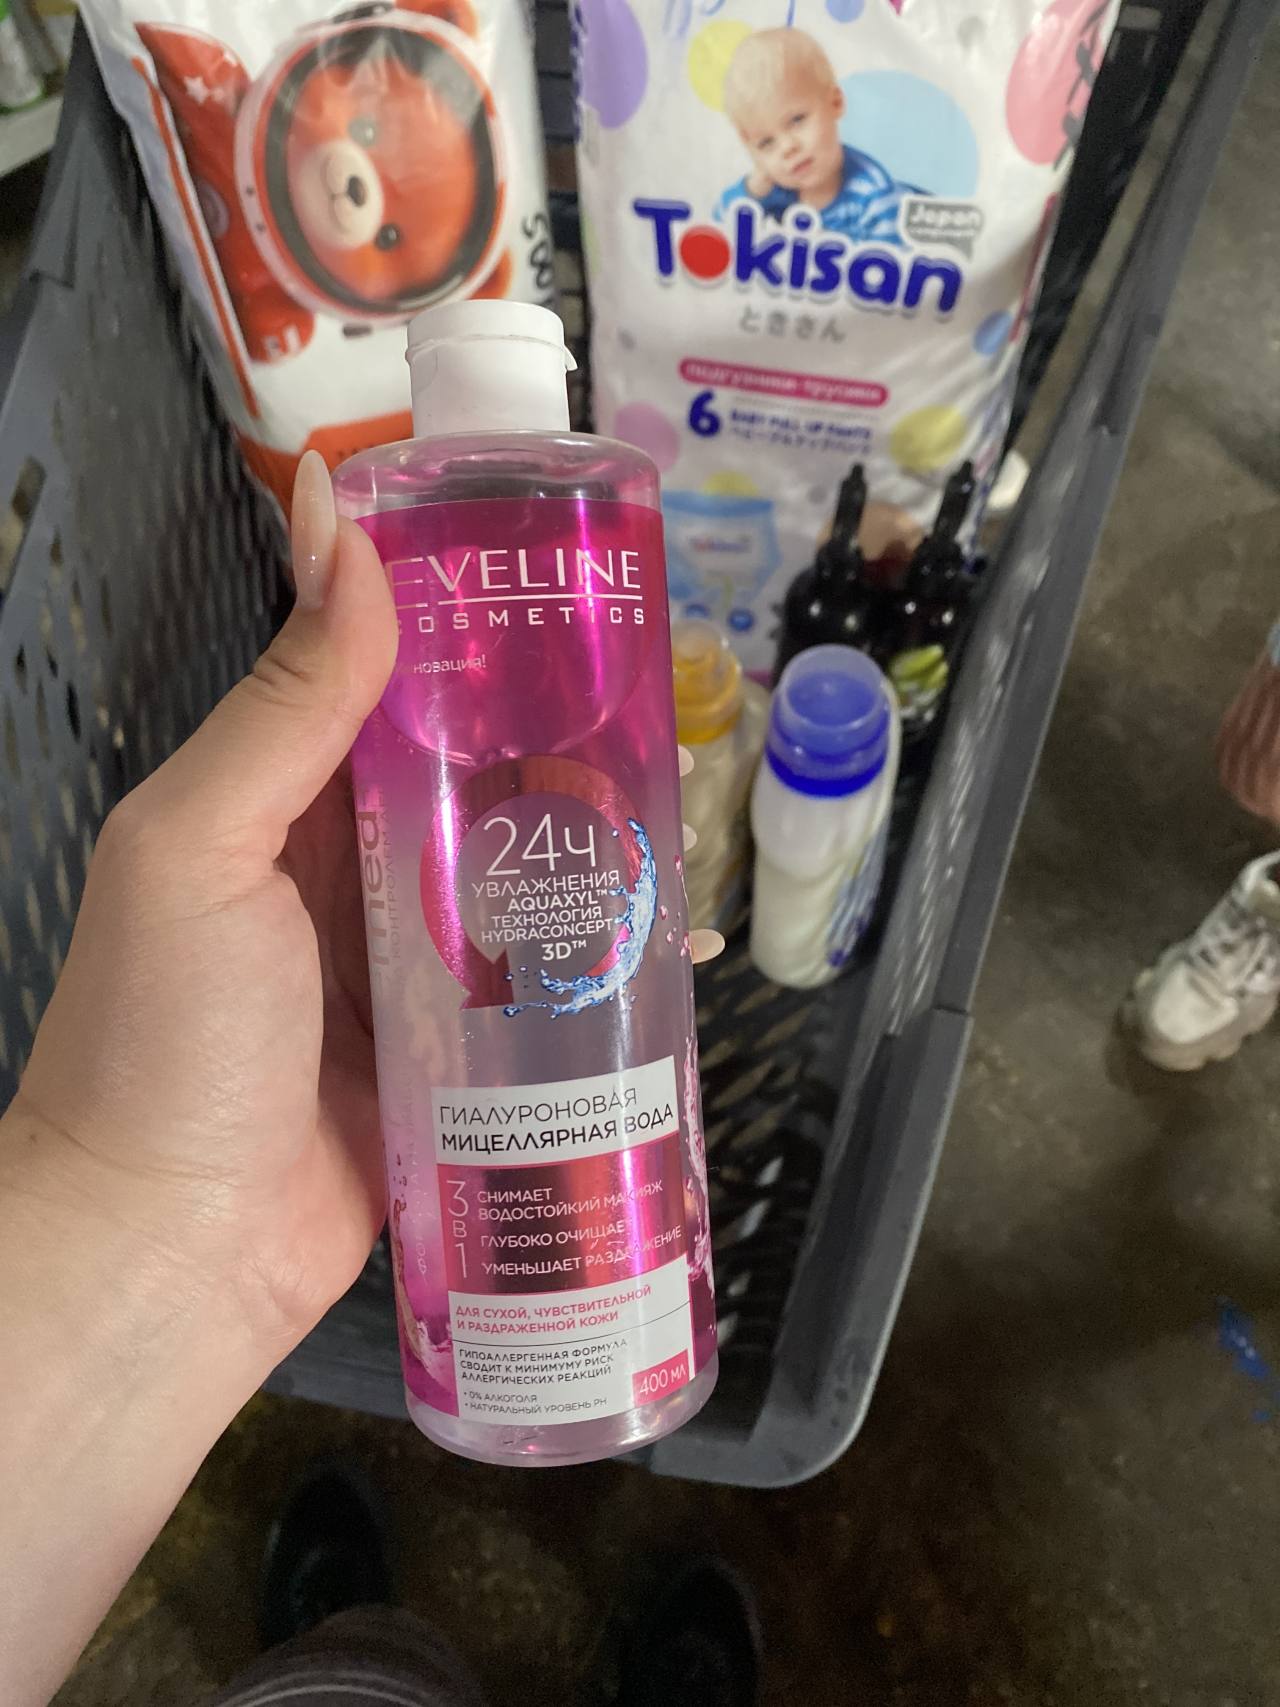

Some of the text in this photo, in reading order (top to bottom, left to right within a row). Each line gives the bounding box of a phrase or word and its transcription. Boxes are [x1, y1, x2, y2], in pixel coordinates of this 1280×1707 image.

[634, 198, 962, 313] Tokisan
[688, 388, 722, 438] 6
[386, 548, 641, 609] EVELINE
[398, 606, 645, 635] OSMETICS
[471, 869, 620, 898] УВЛАЖНЕНИЯ
[492, 906, 603, 929] ТЕХНОЛОГИЯ
[481, 918, 613, 944] HYDRACONCEPT
[439, 1087, 638, 1126] ГИАЛУРОНОВАЯ
[441, 1103, 674, 1155] МИЦЕЛЛЯРНАЯ ВОДА
[447, 1180, 469, 1218] 3
[477, 1188, 553, 1204] СНИМАЕТ
[478, 1196, 601, 1222] ВОДОСТОЙКИЙ
[480, 1232, 552, 1249] ГЛУБОКО
[455, 1242, 469, 1279] 1
[481, 1256, 582, 1276] УМЕНЬШАЕТ
[456, 1284, 651, 1321] ДЛЯ СУХОЙ, ЧУВСТВИТЕЛЬНОЙ
[457, 1311, 619, 1334] И РАЗДРАЖЕННОЙ КОЖИ
[459, 1338, 628, 1363] ГИПОАЛЛЕРГЕННАЯ ФОРМУЛА
[460, 1354, 615, 1374] СВОДИТ К МИНИМУМУ РИСК
[461, 1366, 612, 1385] АЛЛЕРГИЧЕСКИХ РЕАКЦИЙ
[639, 1368, 669, 1396] 400
[470, 1402, 542, 1415] НАТУРАЛЬНЫЙ
[544, 1401, 591, 1414] УРОВЕНЬ
[484, 1393, 538, 1403] АЛКОГОЛЯ
